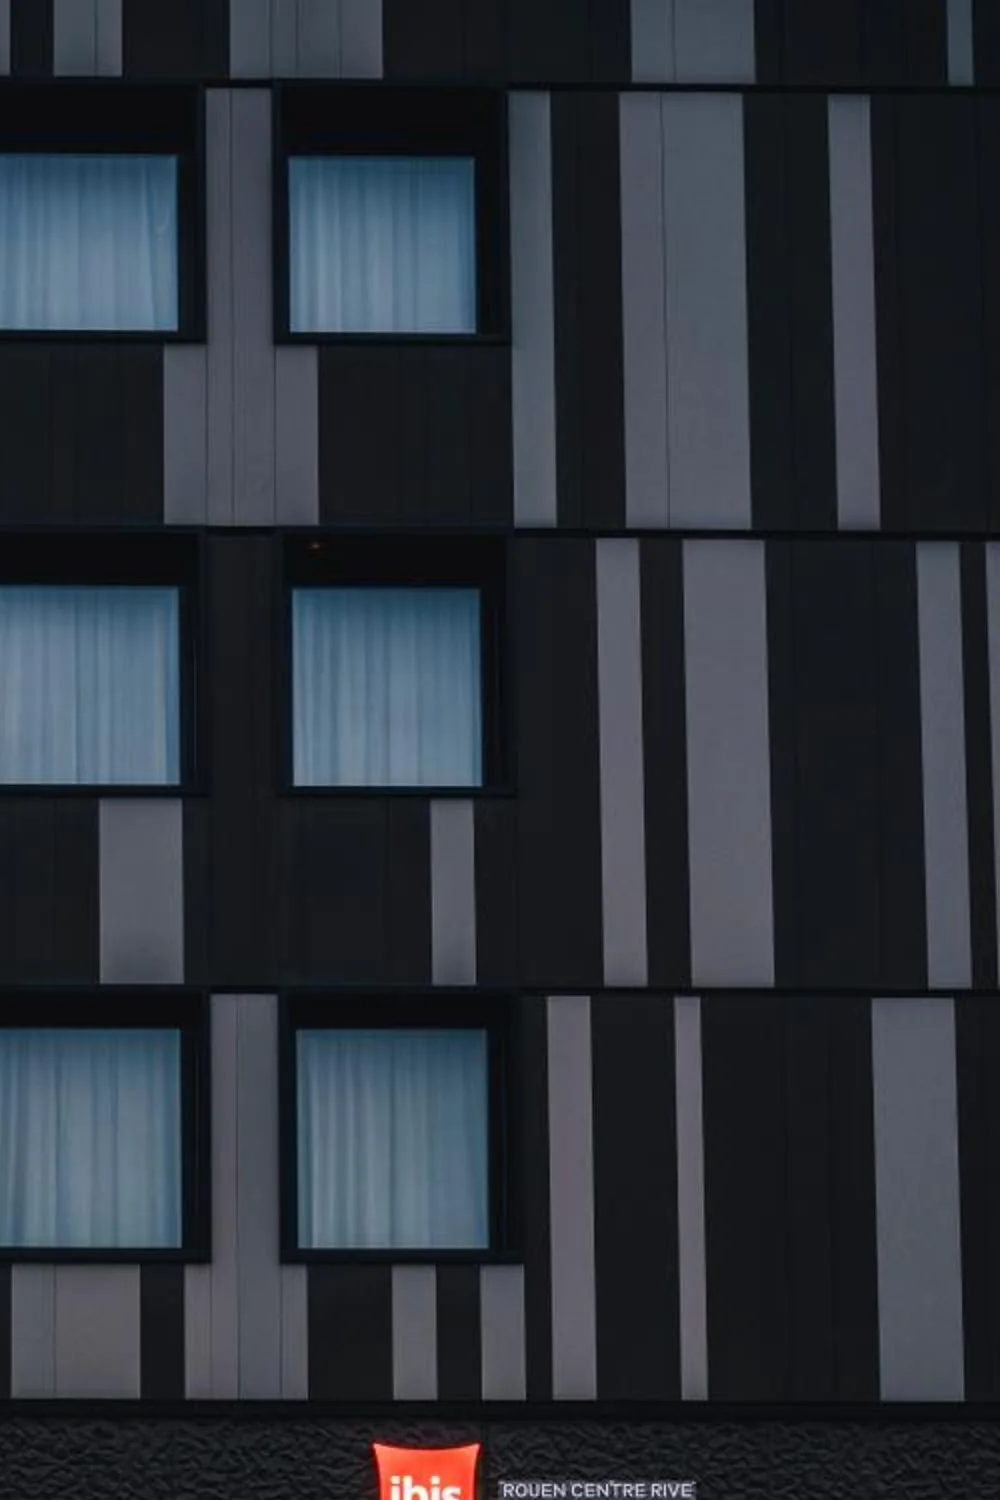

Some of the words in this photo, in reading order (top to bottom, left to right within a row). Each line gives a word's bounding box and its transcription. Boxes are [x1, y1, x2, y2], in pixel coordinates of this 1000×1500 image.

[503, 1482, 567, 1498] ROUEN
[571, 1482, 646, 1498] CENTRE
[650, 1482, 693, 1498] RIVE
